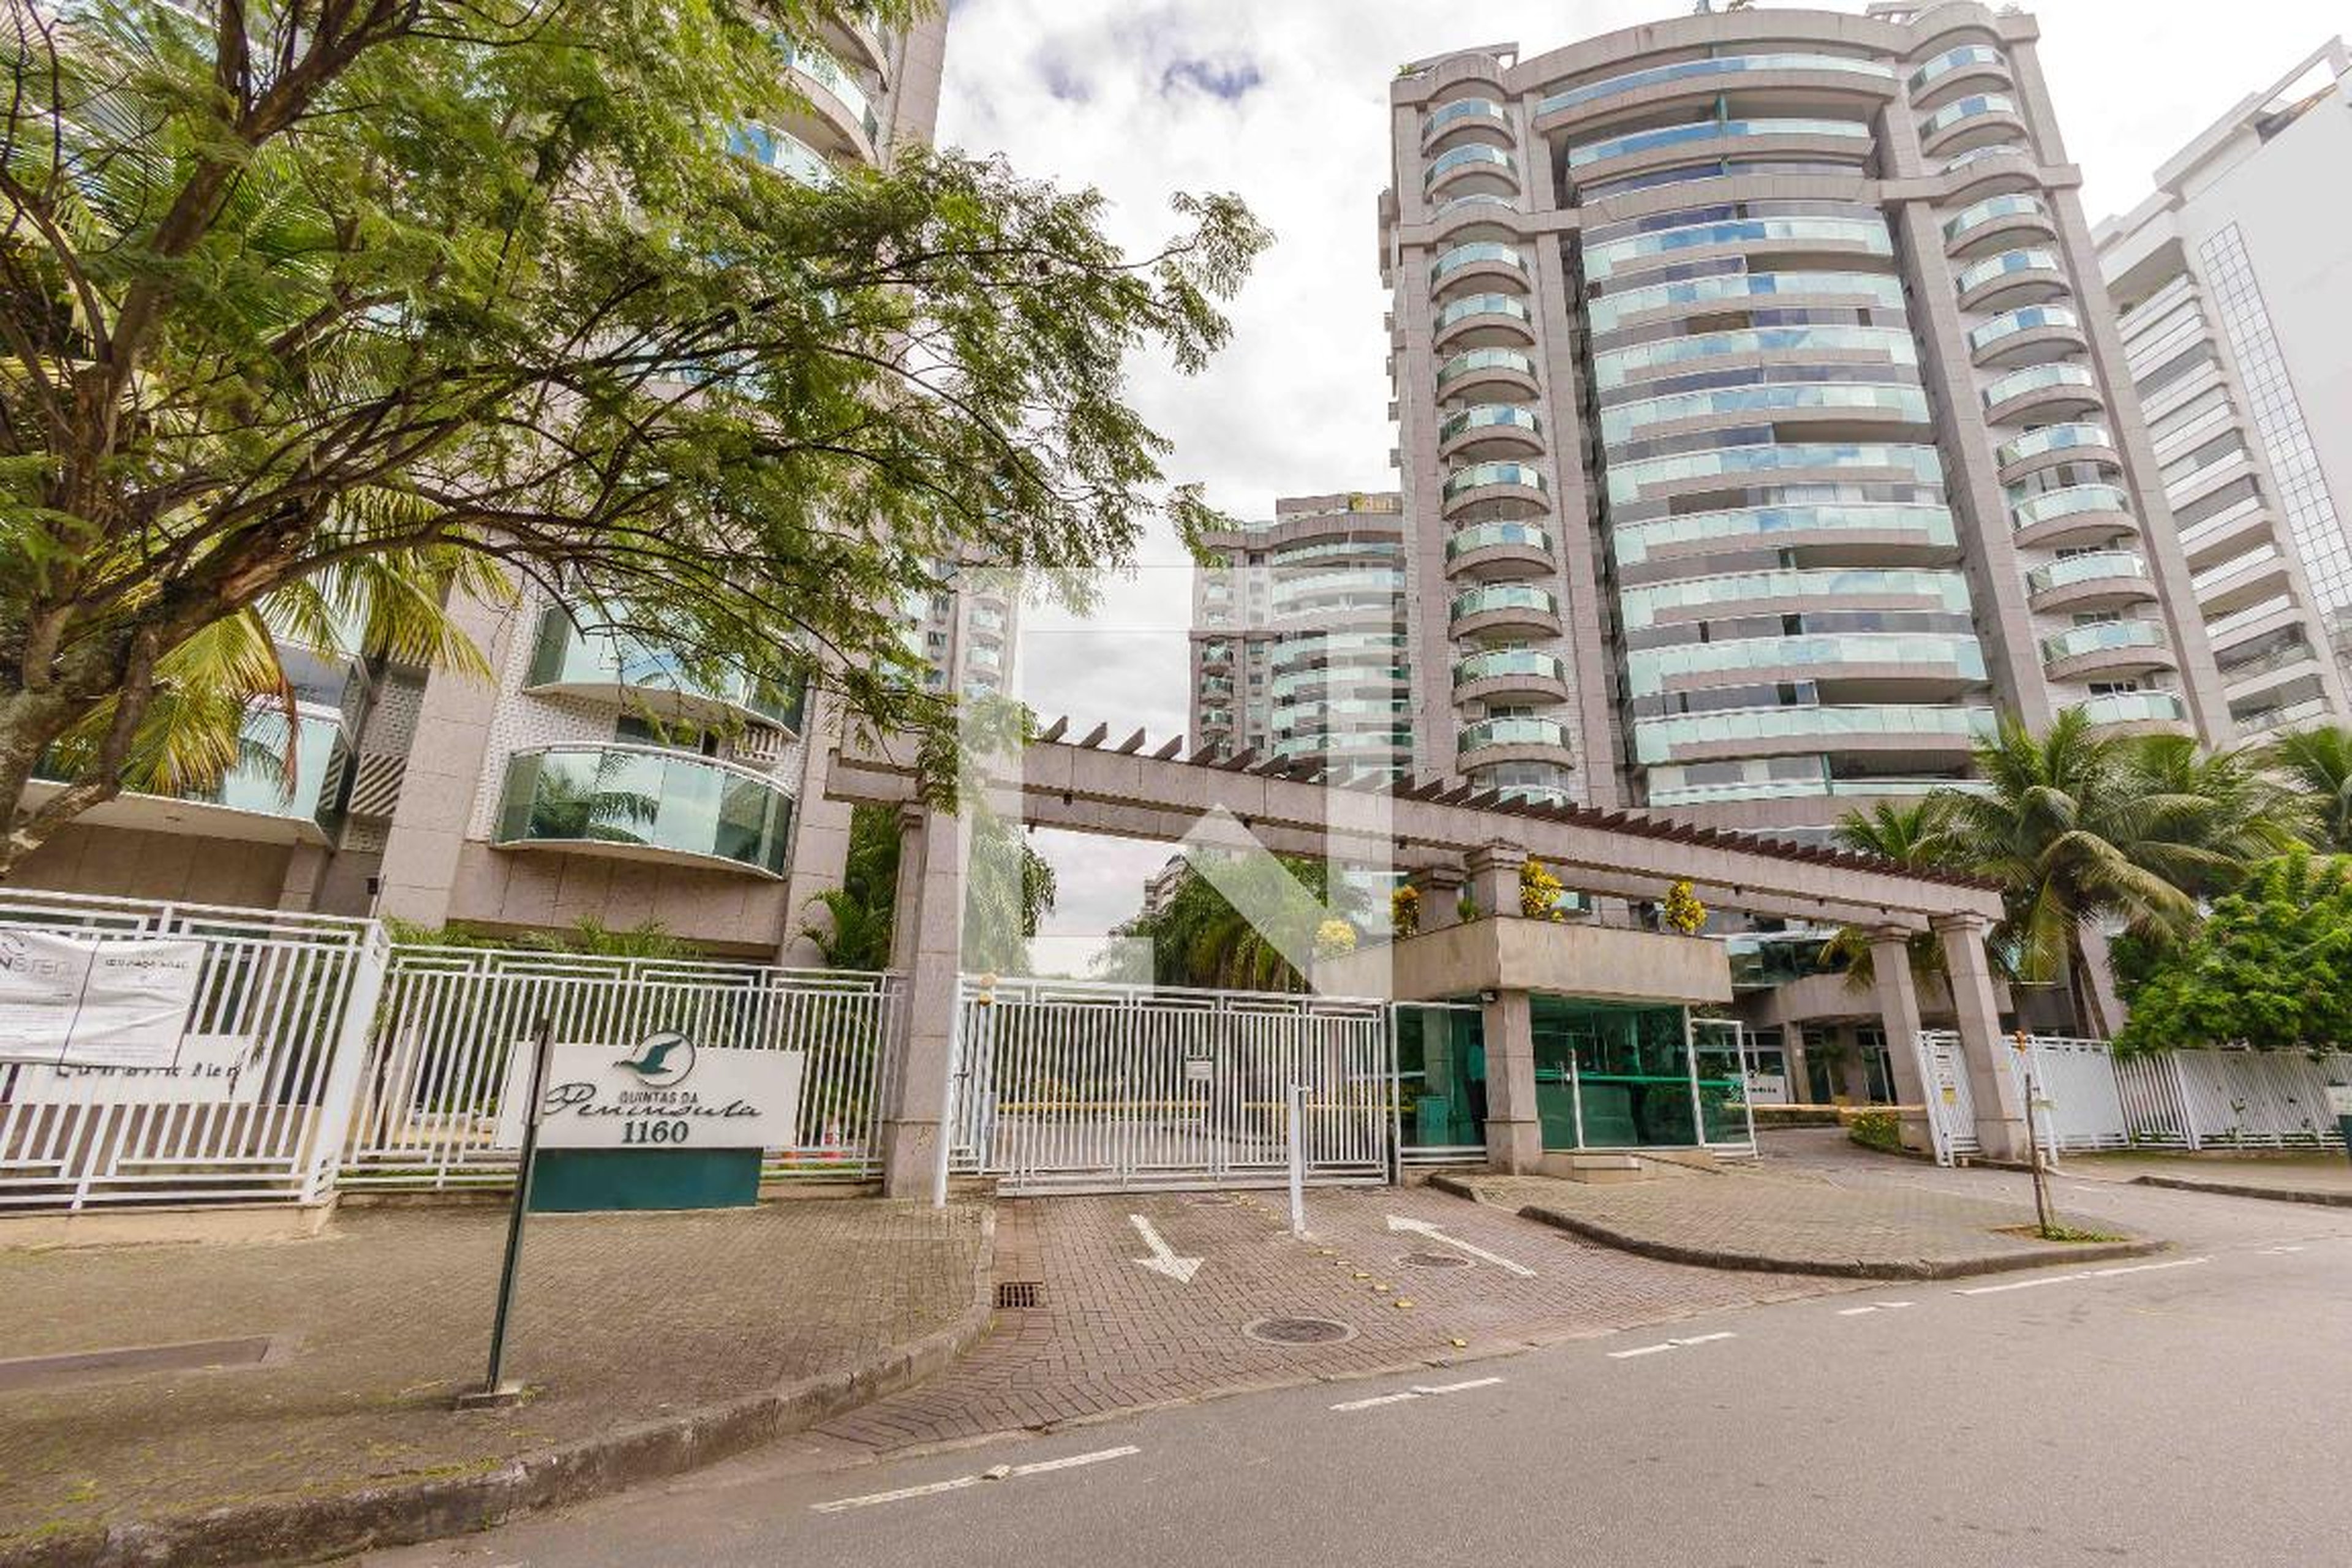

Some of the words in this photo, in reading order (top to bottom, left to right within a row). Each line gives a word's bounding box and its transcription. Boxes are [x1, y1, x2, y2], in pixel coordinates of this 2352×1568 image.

[619, 1091, 675, 1104] QUINTAS
[679, 1092, 699, 1104] DA
[622, 1120, 689, 1144] 1160
